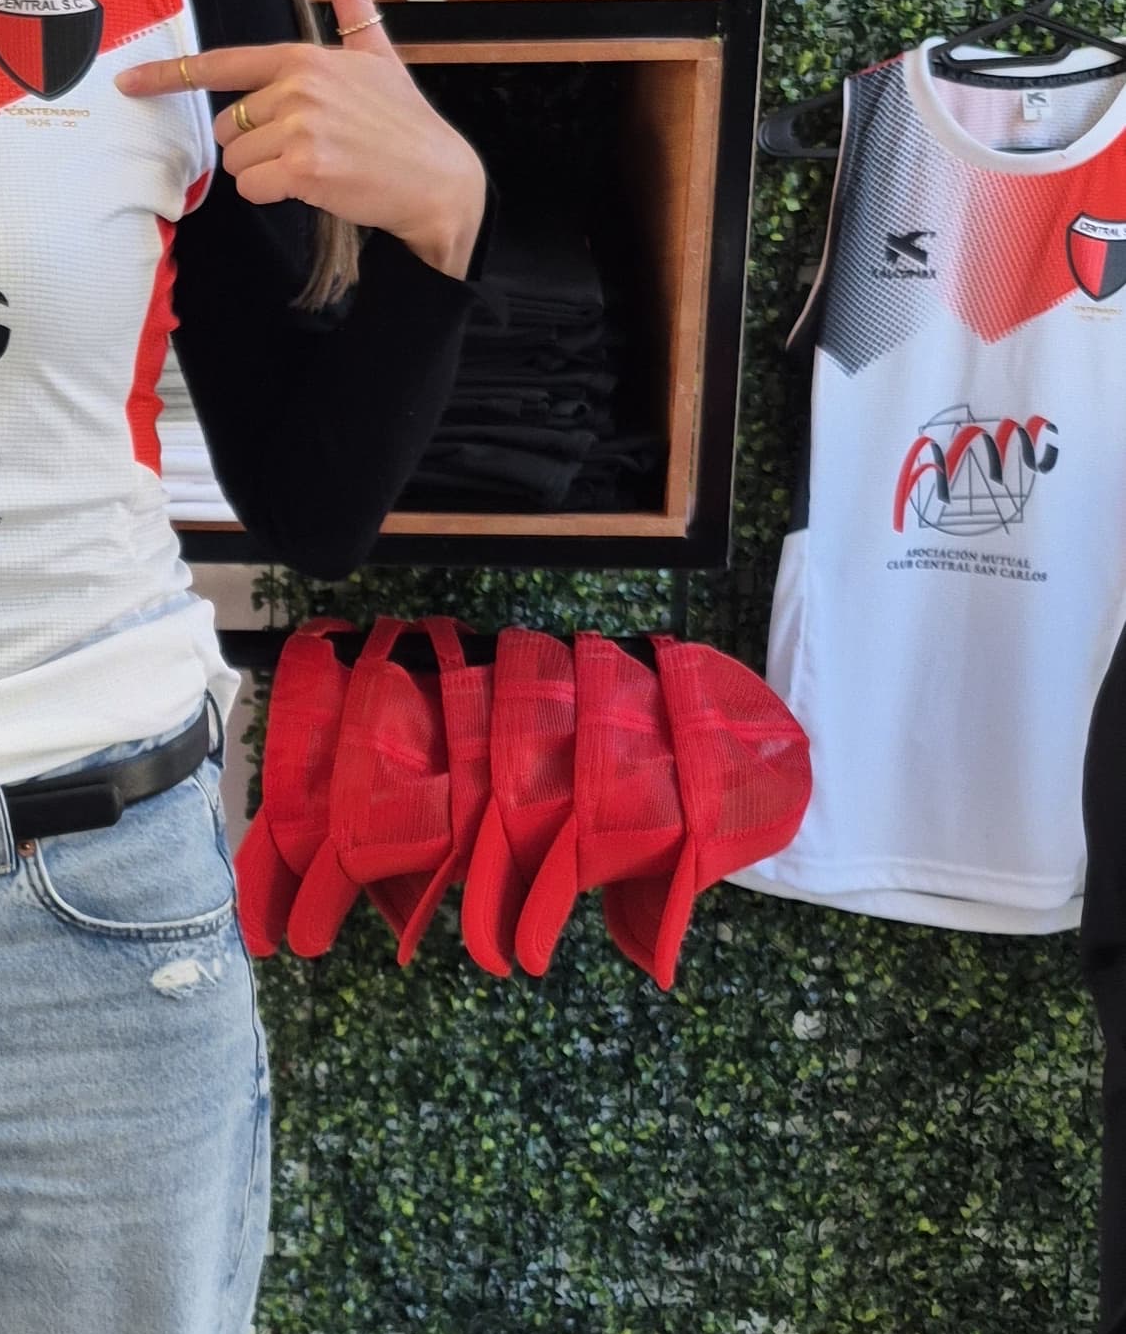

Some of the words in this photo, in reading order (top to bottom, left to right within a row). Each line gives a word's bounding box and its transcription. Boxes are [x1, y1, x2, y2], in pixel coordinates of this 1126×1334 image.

[886, 559, 914, 571] CLUB
[915, 559, 972, 573] CENTRAL
[974, 564, 997, 577] SAN
[999, 567, 1048, 582] CARLOS
[981, 554, 1032, 569] MUTUAL
